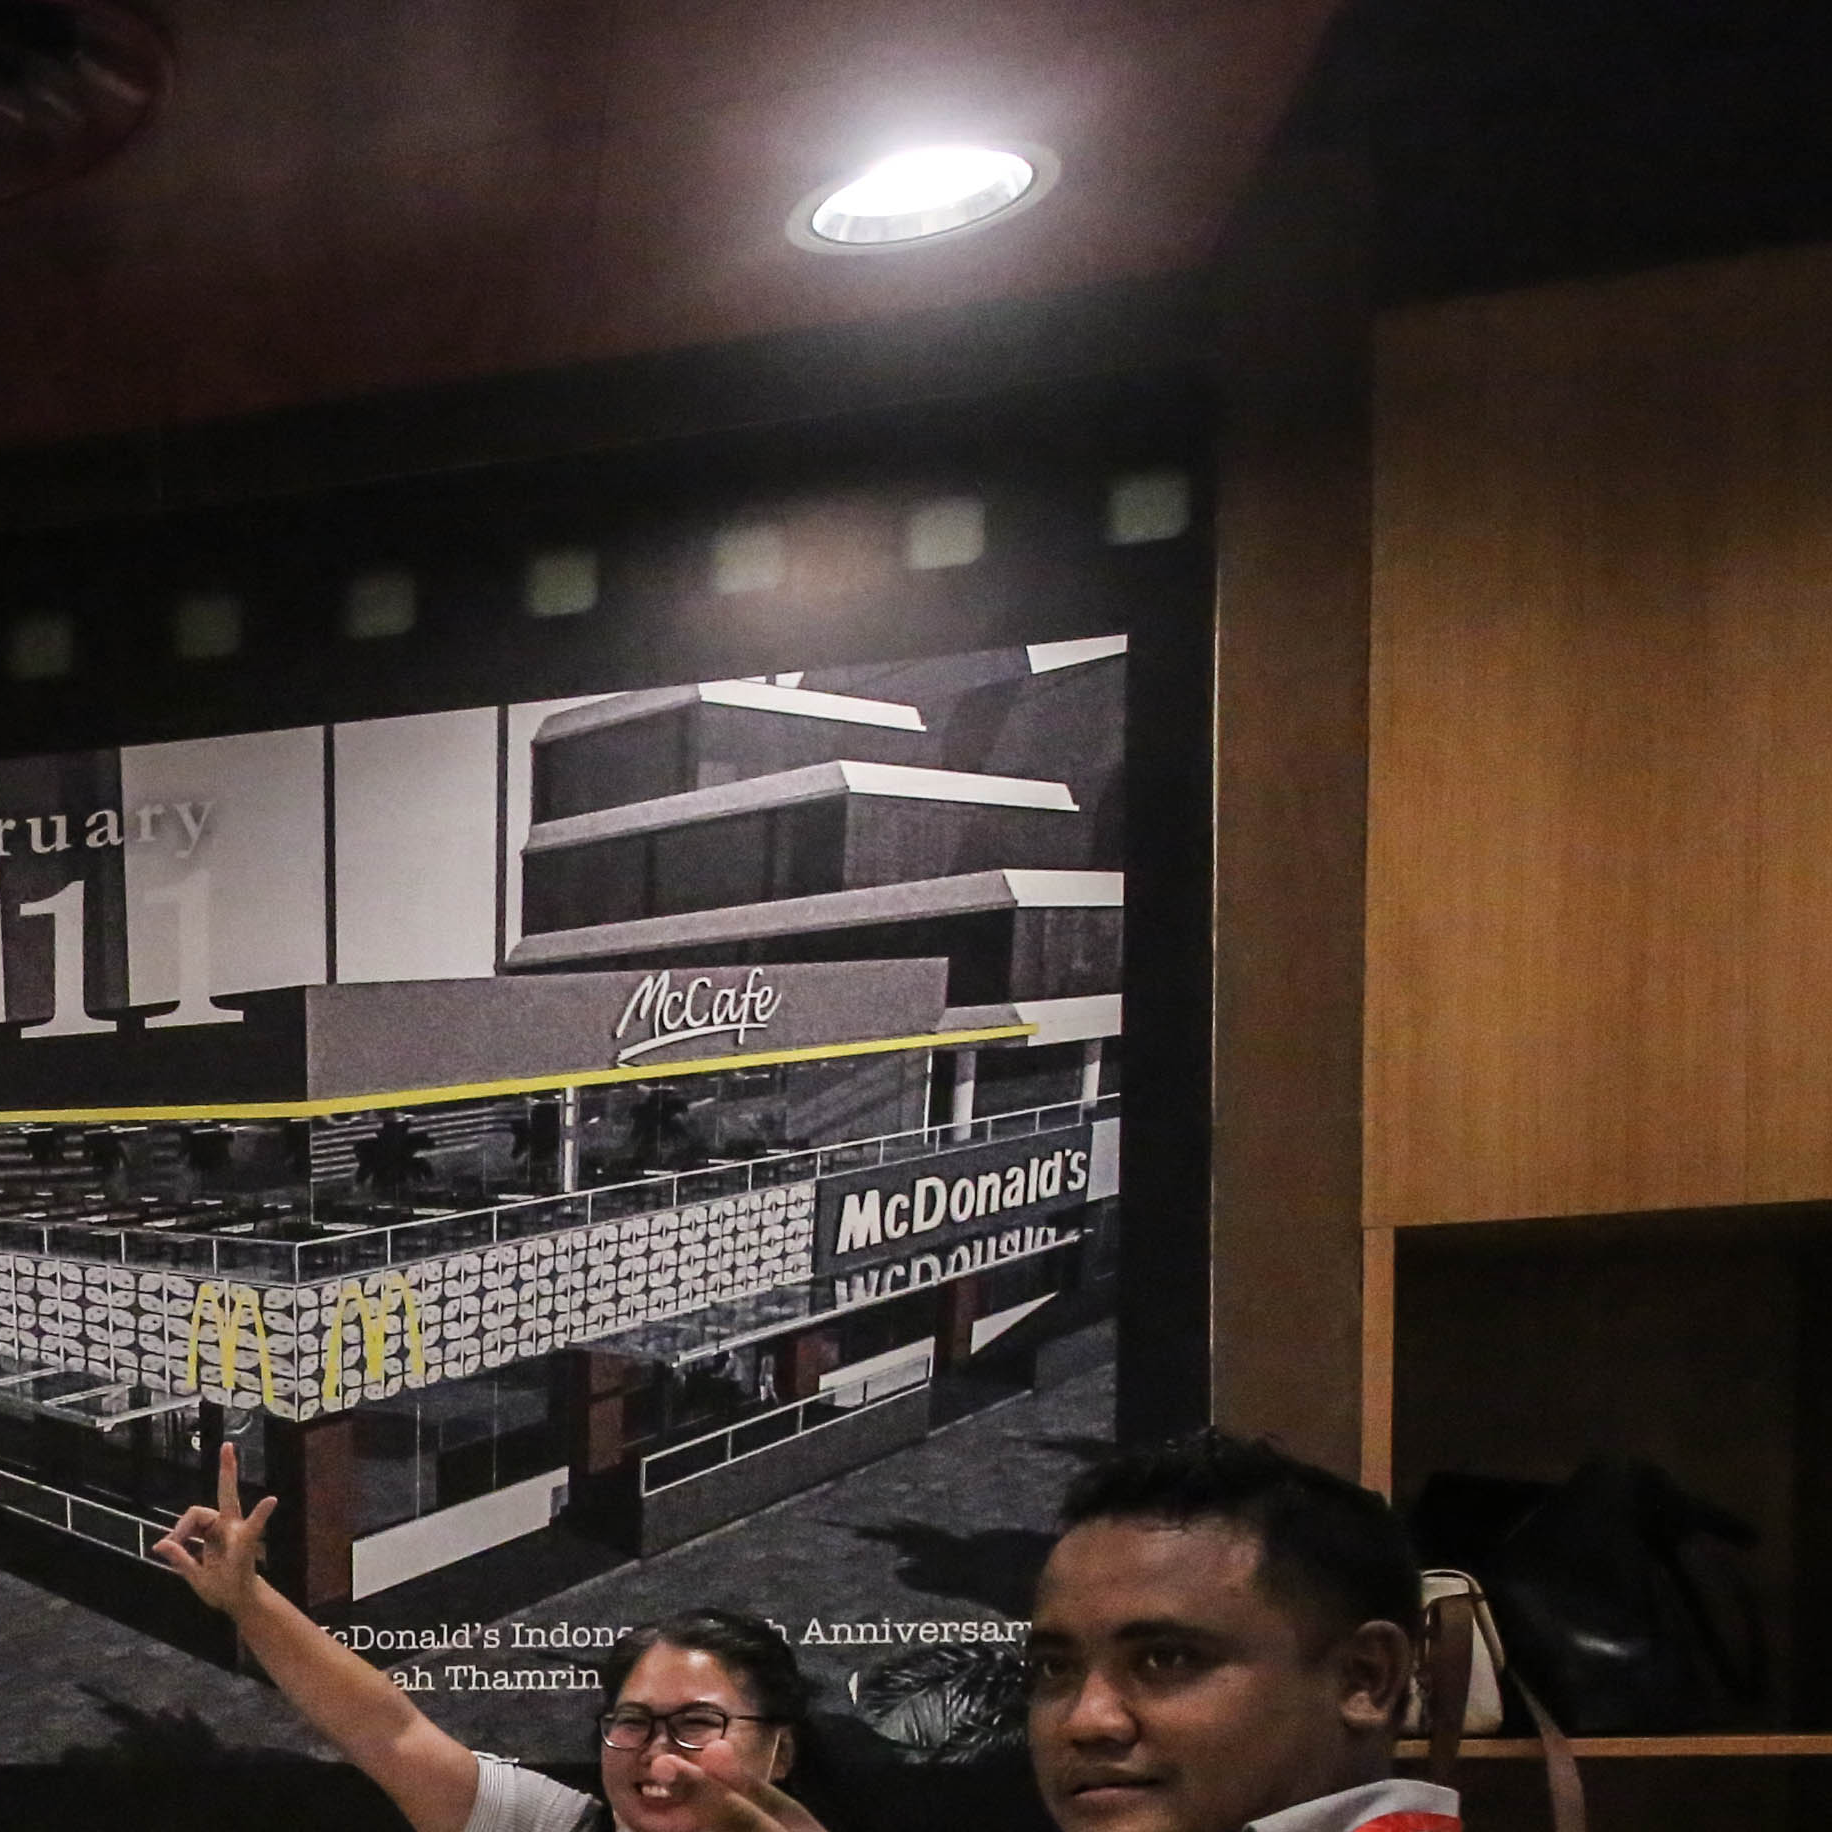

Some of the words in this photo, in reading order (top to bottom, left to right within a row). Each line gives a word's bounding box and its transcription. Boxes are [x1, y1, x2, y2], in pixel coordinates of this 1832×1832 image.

[836, 1148, 1089, 1254] McDonald's
[320, 1622, 501, 1651] cDonald's
[445, 1665, 602, 1691] Thamrin
